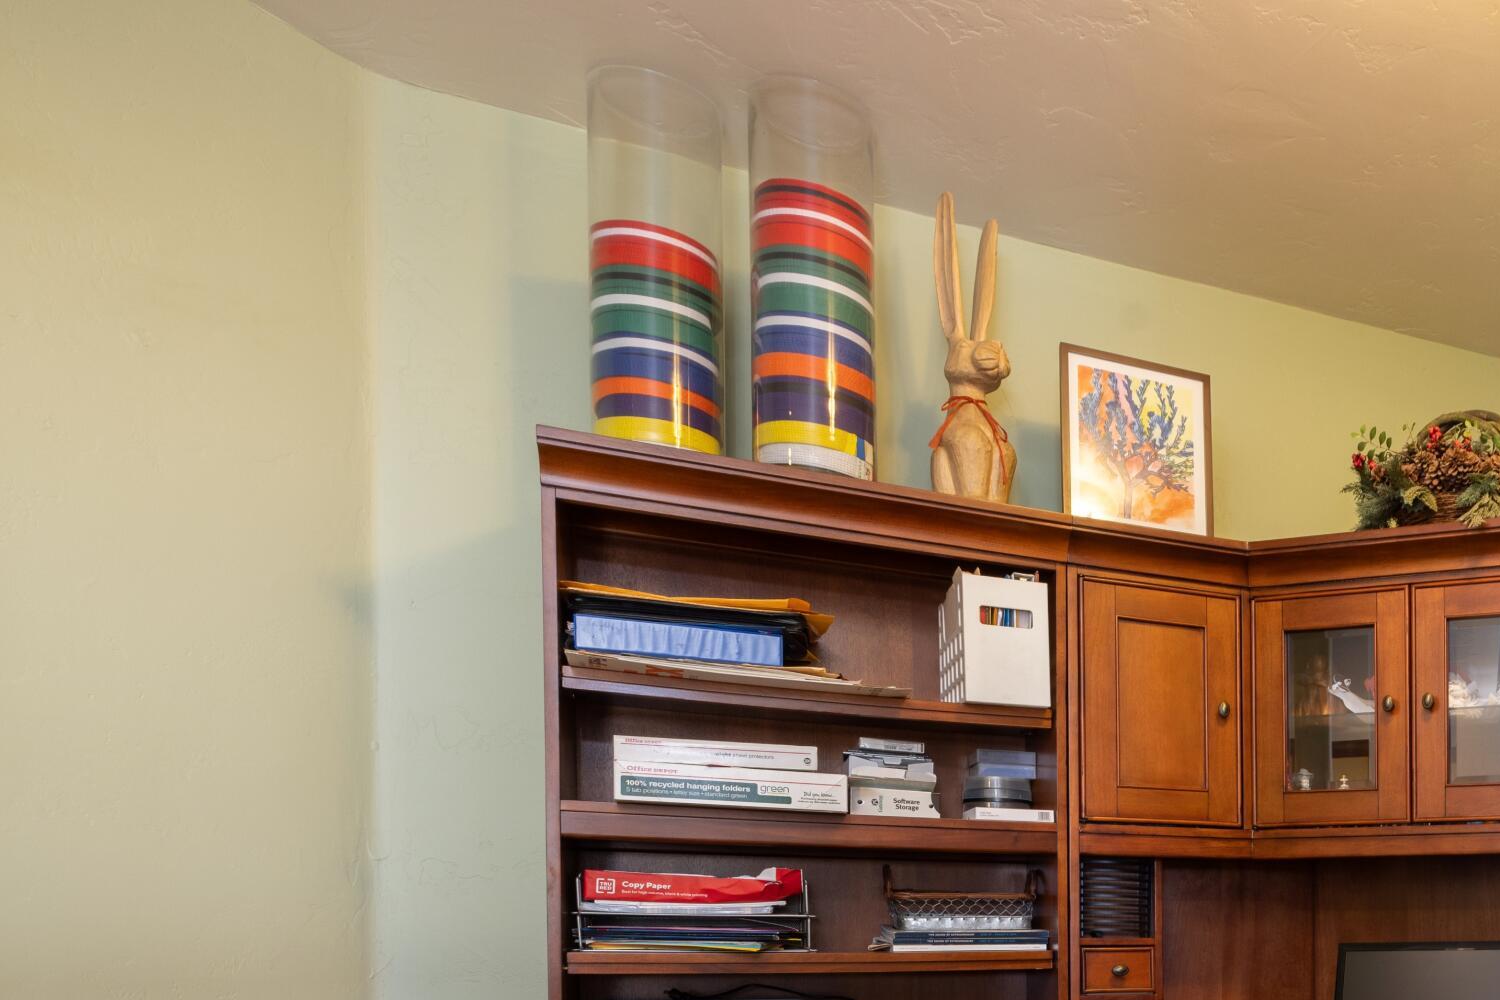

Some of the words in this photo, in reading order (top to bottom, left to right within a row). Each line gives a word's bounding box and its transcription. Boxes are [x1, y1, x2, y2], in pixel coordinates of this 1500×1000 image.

[649, 780, 685, 790] recycled
[687, 782, 721, 792] hanging
[722, 784, 751, 793] folders
[760, 784, 790, 795] green
[893, 797, 921, 806] Software
[895, 804, 920, 813] Storage
[622, 881, 645, 890] Copy
[646, 881, 671, 891] Paper
